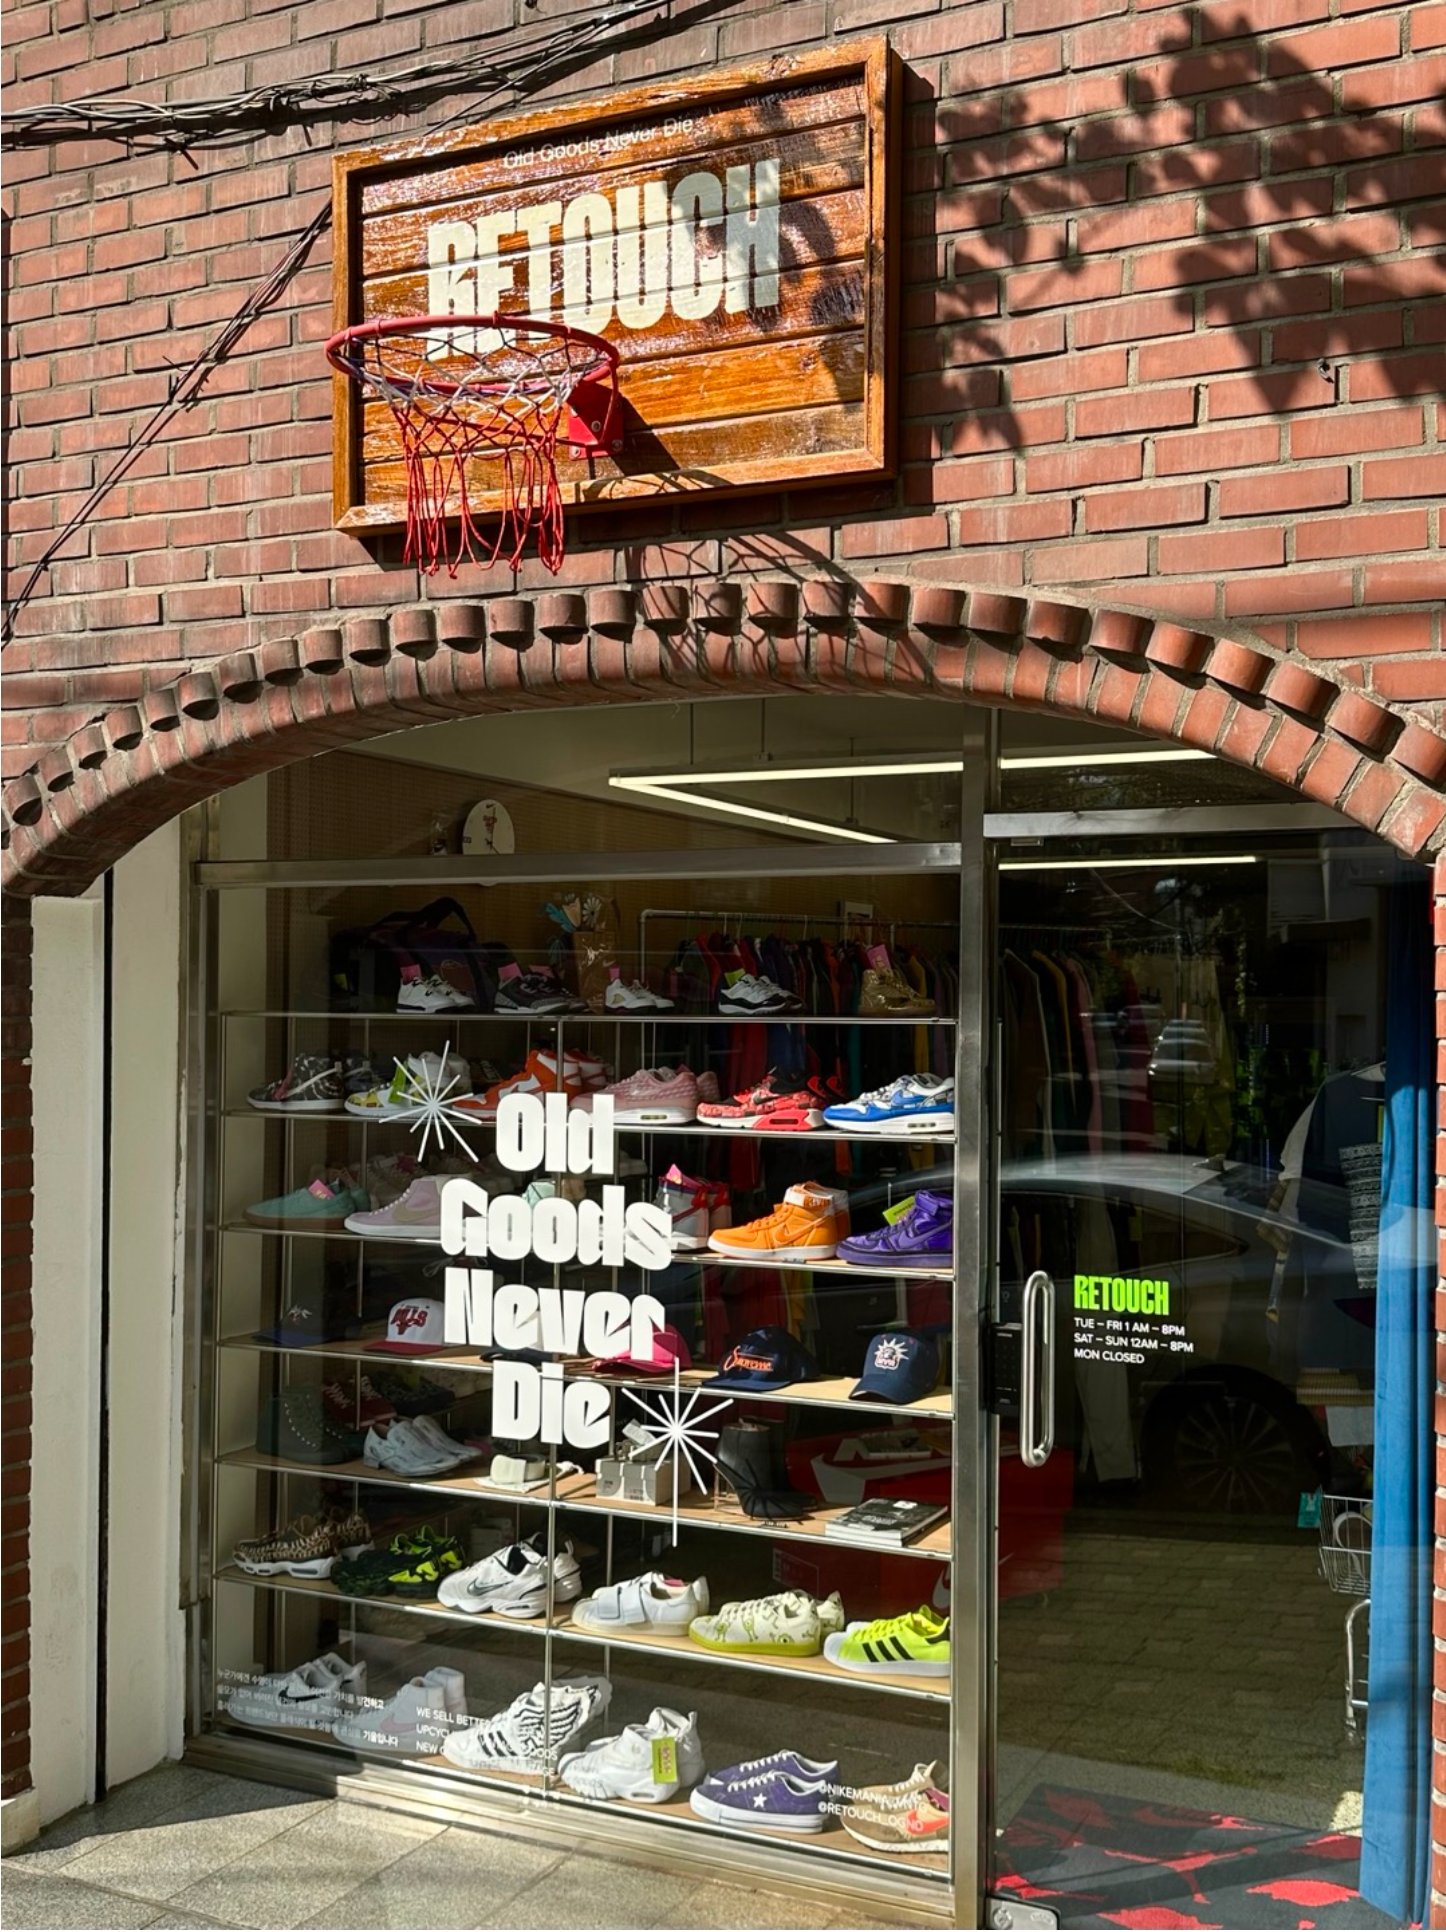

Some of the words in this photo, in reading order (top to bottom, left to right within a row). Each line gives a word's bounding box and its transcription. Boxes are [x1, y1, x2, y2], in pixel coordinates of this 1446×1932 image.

[504, 147, 534, 169] Old
[540, 138, 600, 162] Goods
[603, 128, 657, 151] Never
[663, 117, 694, 138] Die
[427, 158, 781, 361] RETOUCH
[496, 1092, 615, 1175] Old
[440, 1177, 673, 1271] Goods
[444, 1266, 666, 1361] Never
[1073, 1274, 1170, 1316] RETOUCH
[1073, 1316, 1096, 1329] TUE
[1106, 1319, 1123, 1331] FRI
[1161, 1324, 1186, 1337] 8PM
[1073, 1332, 1094, 1344] SAT
[1105, 1335, 1128, 1347] SUN
[1130, 1337, 1159, 1350] 12AM
[1169, 1340, 1194, 1353] 8PM
[1073, 1347, 1100, 1360] MON
[1102, 1350, 1145, 1364] CLOSED
[491, 1359, 611, 1450] Die
[416, 1706, 431, 1719] WE
[432, 1709, 454, 1723] SELL
[416, 1741, 439, 1755] NEW
